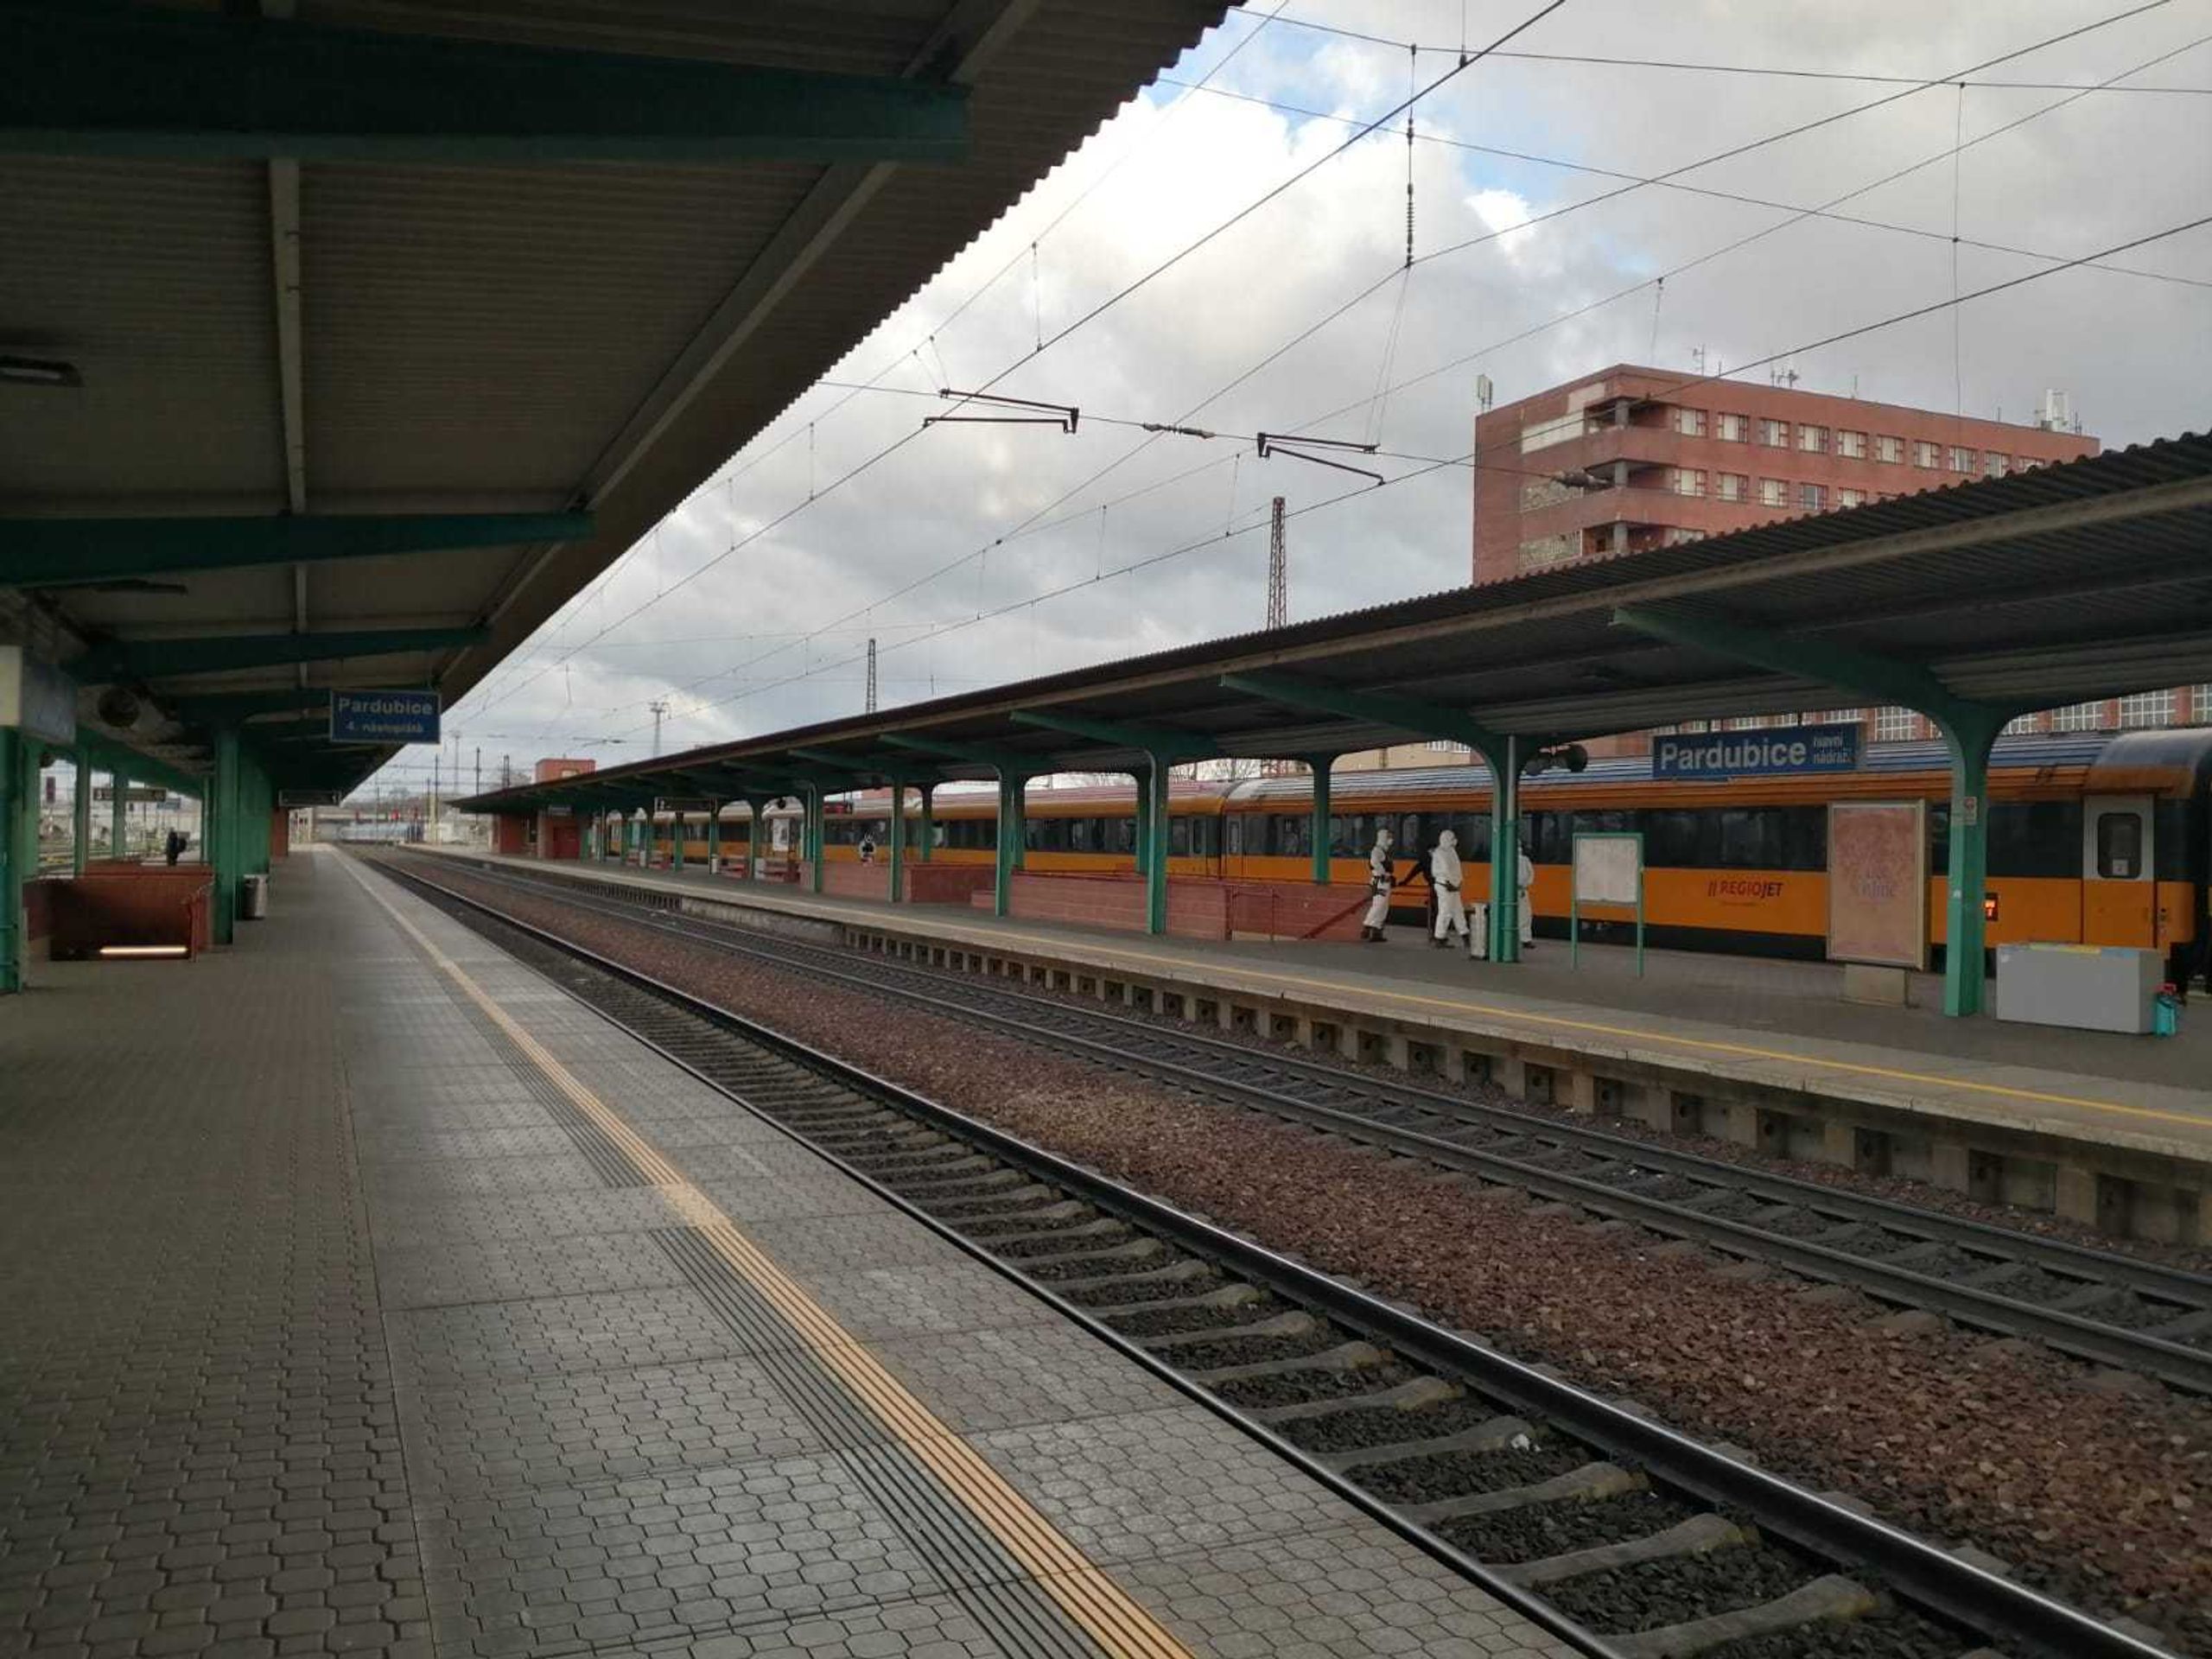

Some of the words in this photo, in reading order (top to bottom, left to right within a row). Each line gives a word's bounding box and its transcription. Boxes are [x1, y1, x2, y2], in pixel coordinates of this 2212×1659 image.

[338, 697, 433, 715] Pardubice
[1660, 738, 1807, 770] Pardubice
[1719, 880, 1784, 899] REGIOJET
